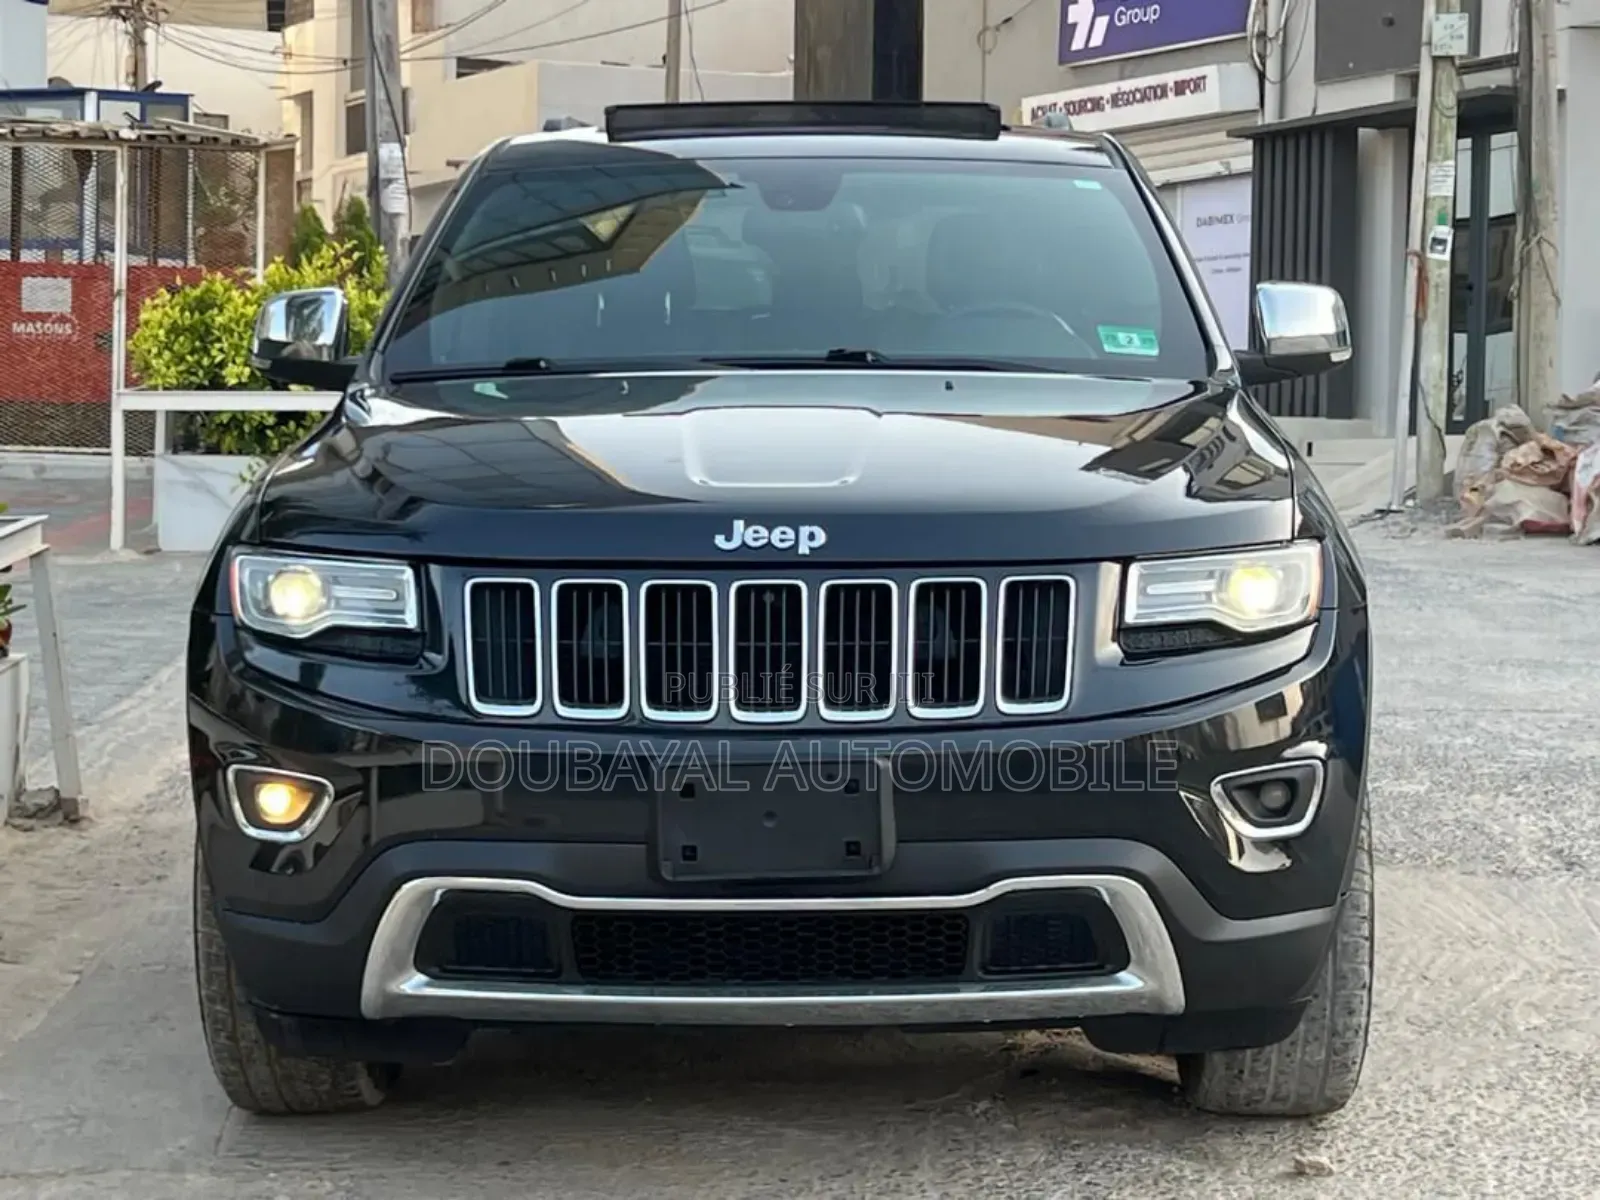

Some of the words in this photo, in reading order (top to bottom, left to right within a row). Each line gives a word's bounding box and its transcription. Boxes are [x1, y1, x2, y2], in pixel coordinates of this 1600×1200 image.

[1114, 4, 1161, 26] Group
[1063, 95, 1105, 116] SOURCING
[1174, 75, 1208, 98] IMPORT
[11, 321, 73, 335] MASONS
[714, 520, 827, 555] Jeep
